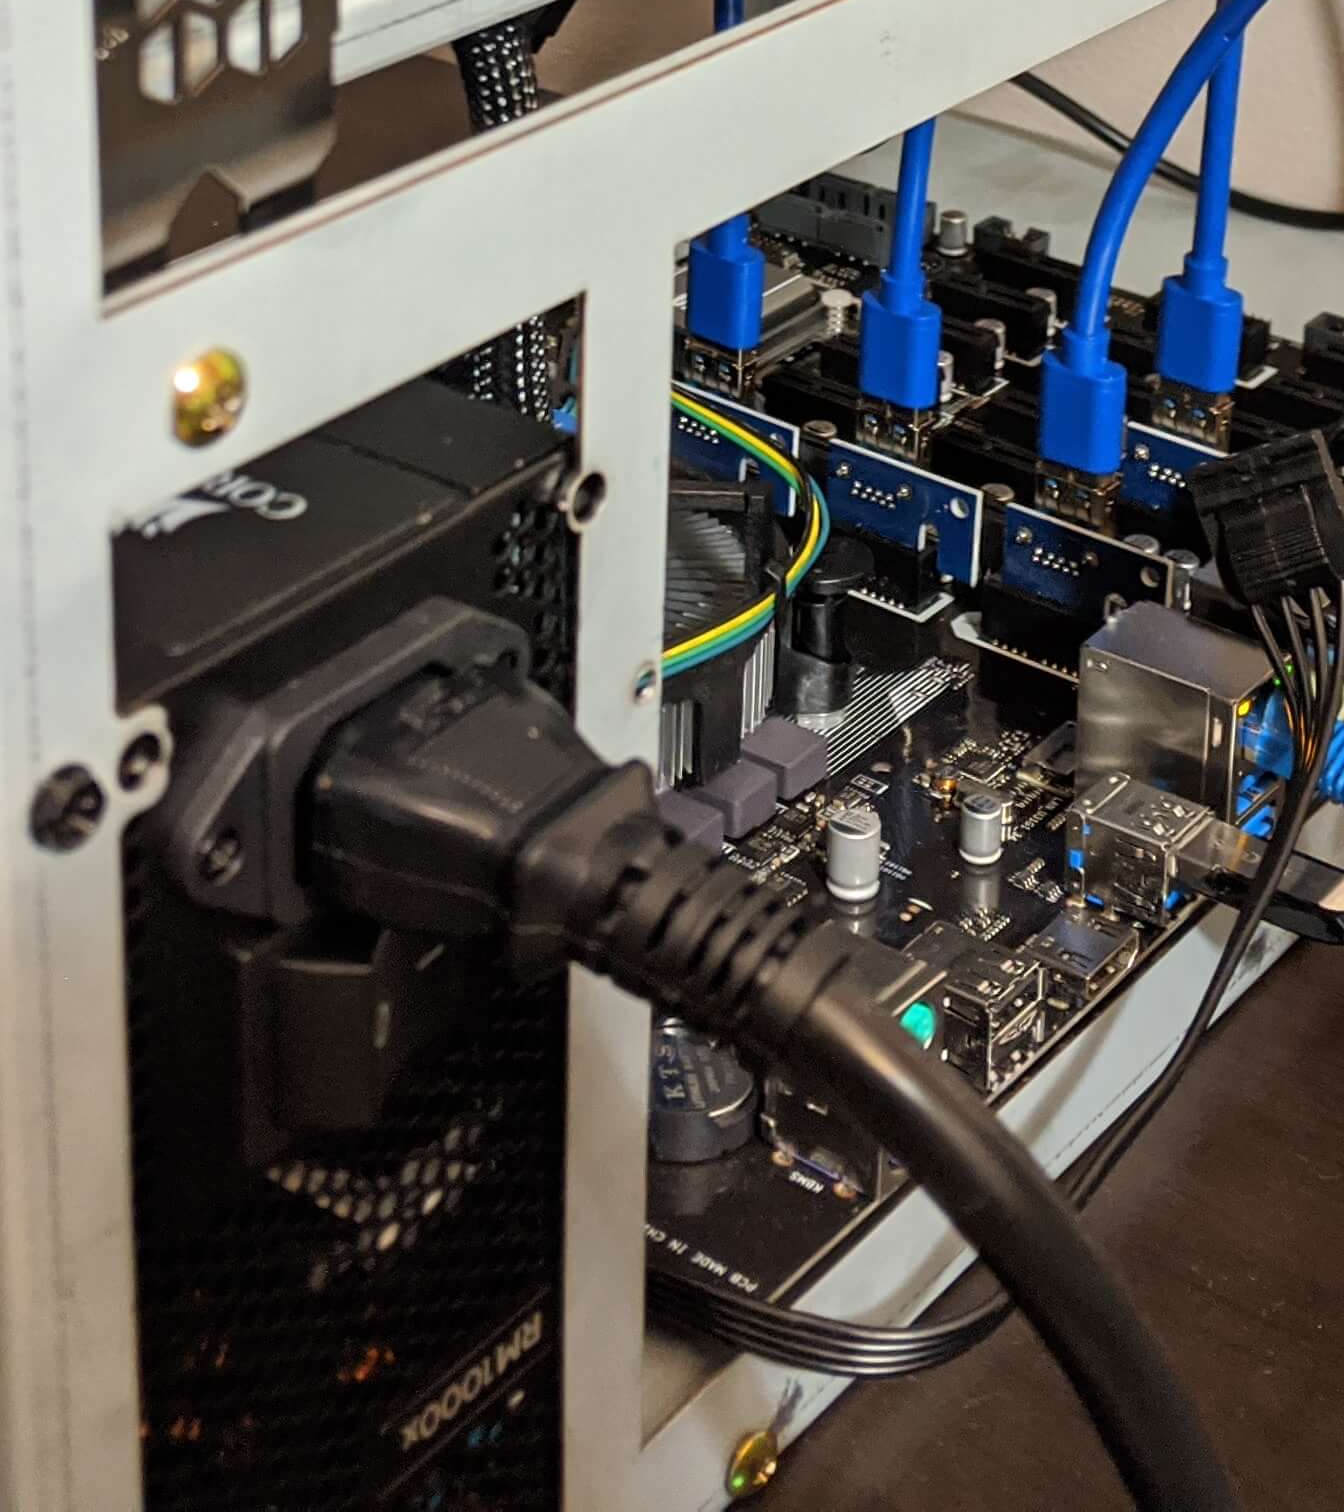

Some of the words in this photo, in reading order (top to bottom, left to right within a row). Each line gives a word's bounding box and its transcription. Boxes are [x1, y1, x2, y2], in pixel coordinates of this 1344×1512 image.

[668, 1240, 688, 1255] IN
[691, 1252, 728, 1277] MADE
[729, 1271, 759, 1293] PCB
